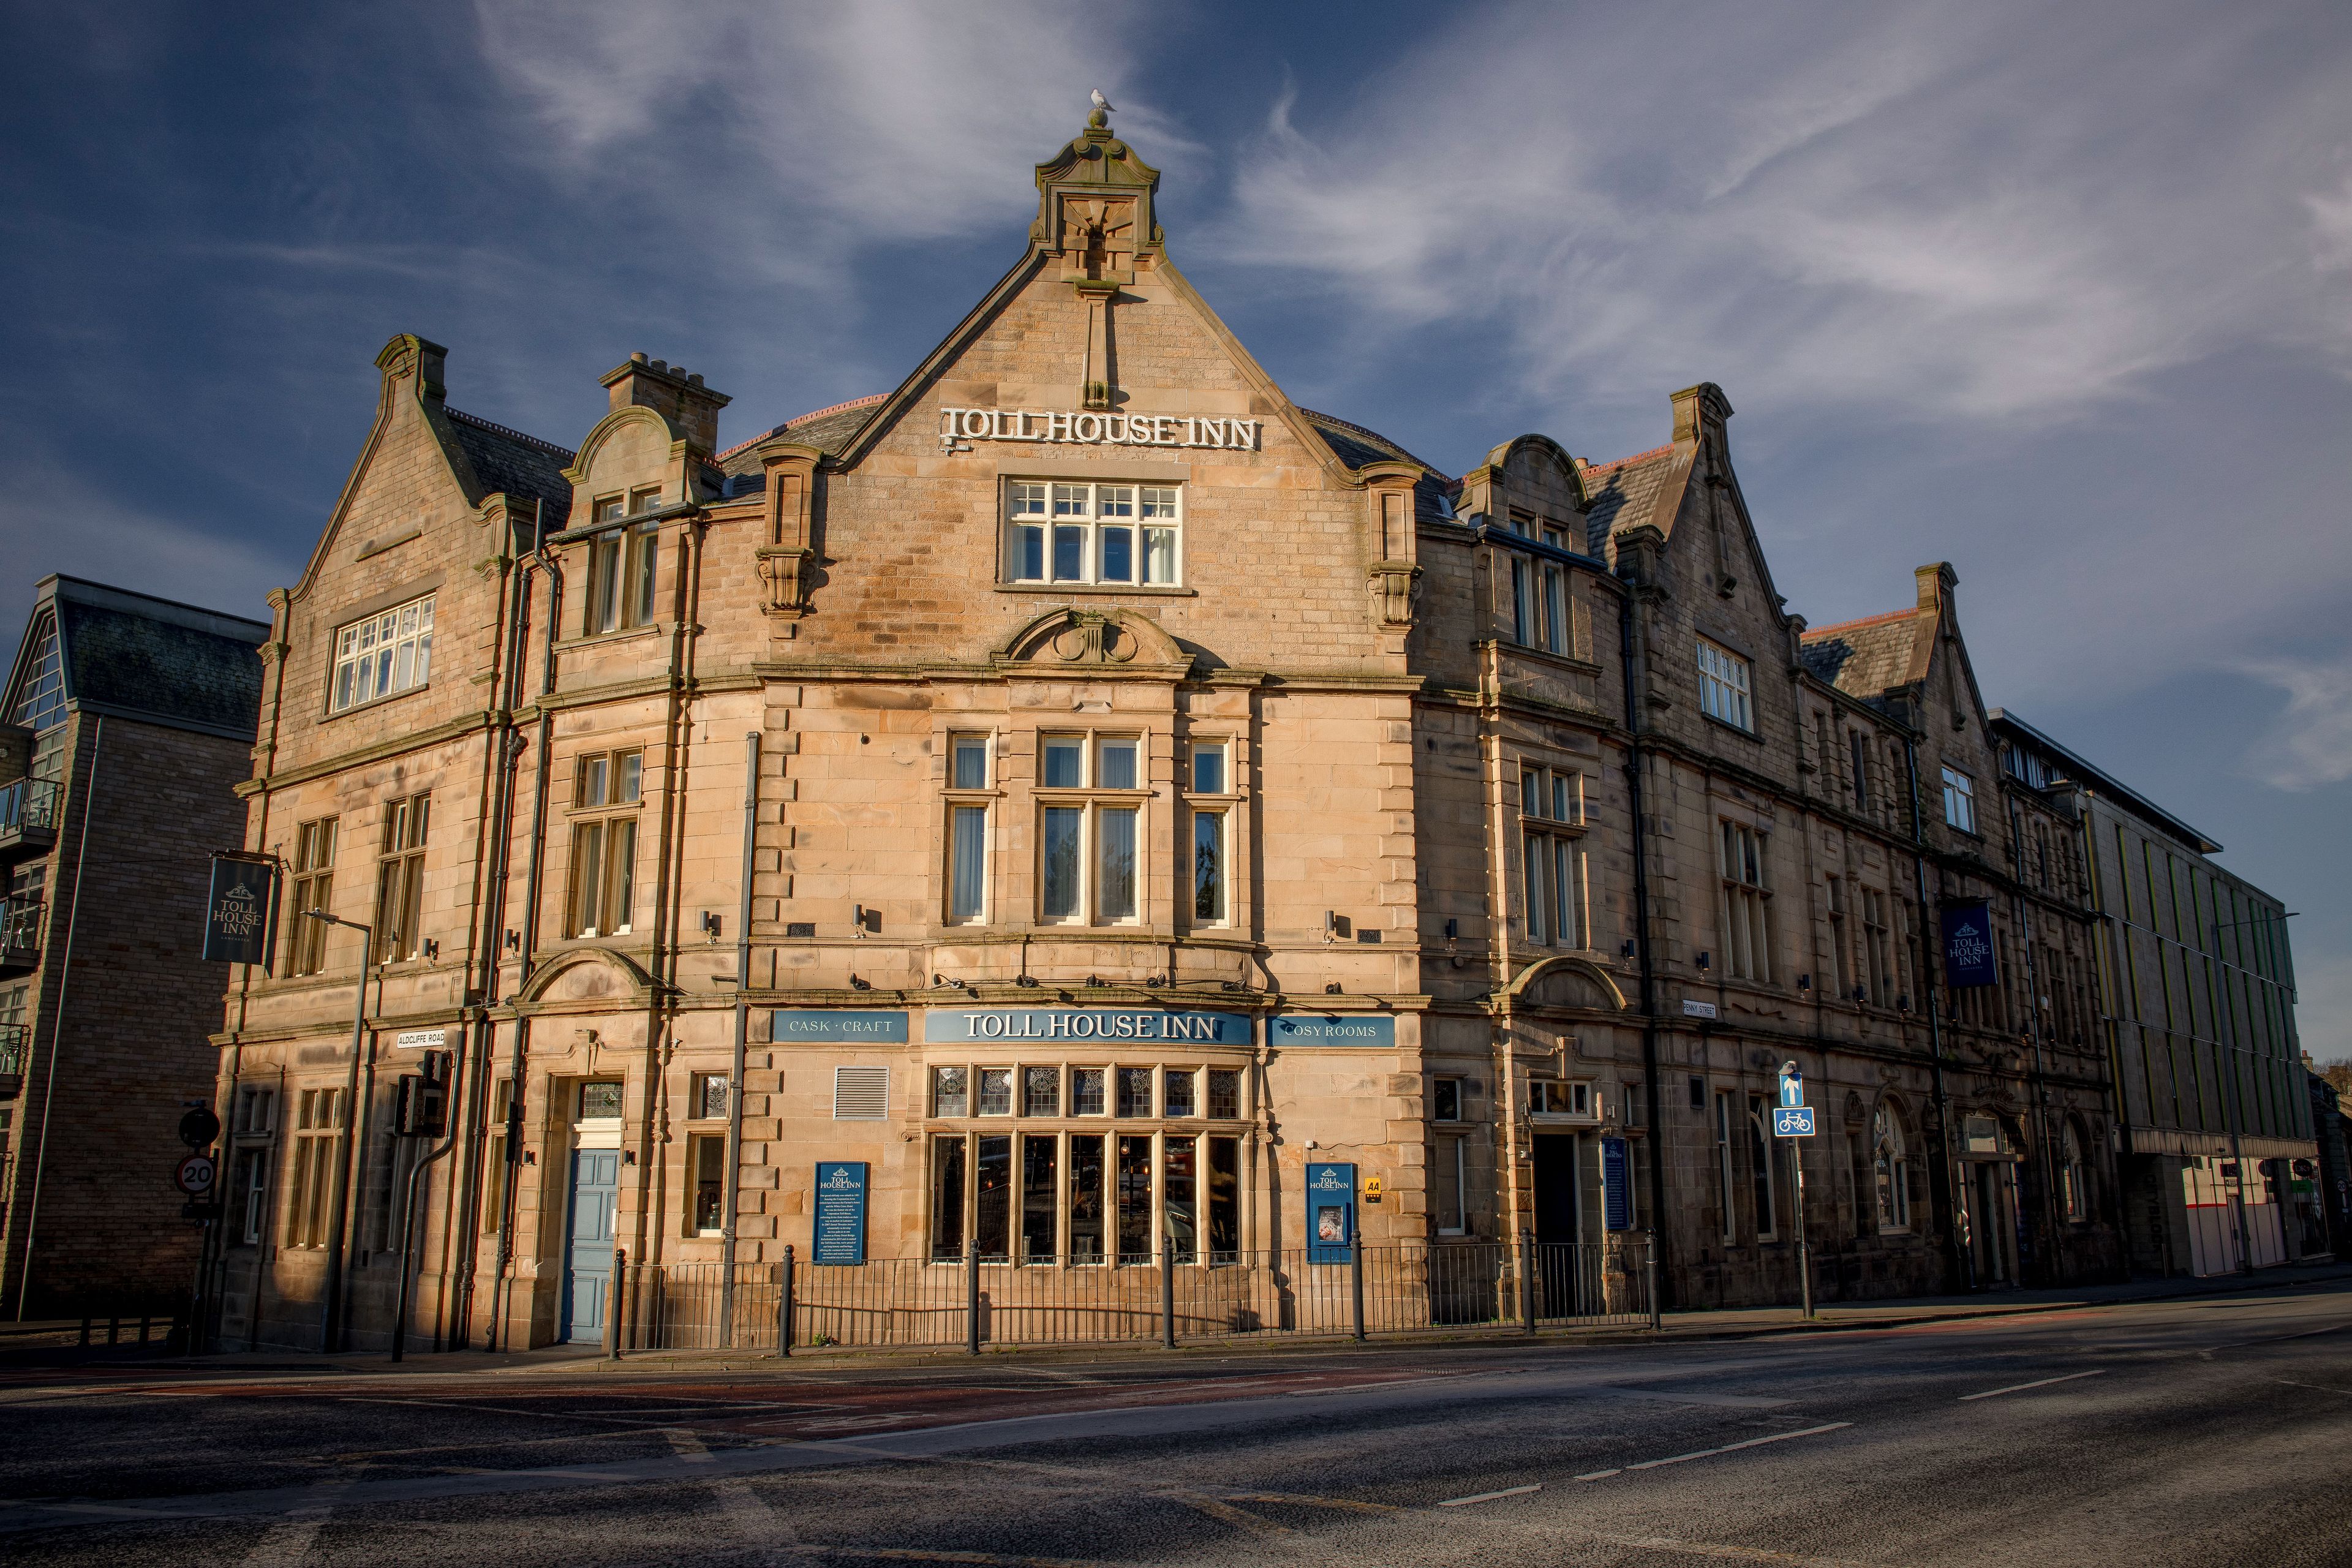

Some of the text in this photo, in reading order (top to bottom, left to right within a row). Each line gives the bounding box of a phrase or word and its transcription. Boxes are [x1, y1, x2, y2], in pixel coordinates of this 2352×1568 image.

[941, 408, 1256, 448] TOLL HOUSE INN
[221, 900, 257, 914] TOLL
[213, 910, 262, 925] HOUSE
[222, 922, 251, 935] INN
[1952, 937, 1984, 948] TOLL
[1950, 945, 1989, 957] HOUSE
[1959, 955, 1981, 965] INN
[1684, 1003, 1714, 1014] PENNY STREET
[790, 1020, 893, 1033] CASK CRAFT
[963, 1014, 1216, 1039] TOLL HOUSE INN
[1285, 1025, 1376, 1037] COSY ROOMS
[399, 1033, 445, 1044] ALDCLIFFE ROAD
[184, 1166, 211, 1183] 20
[1367, 1182, 1379, 1191] AA
